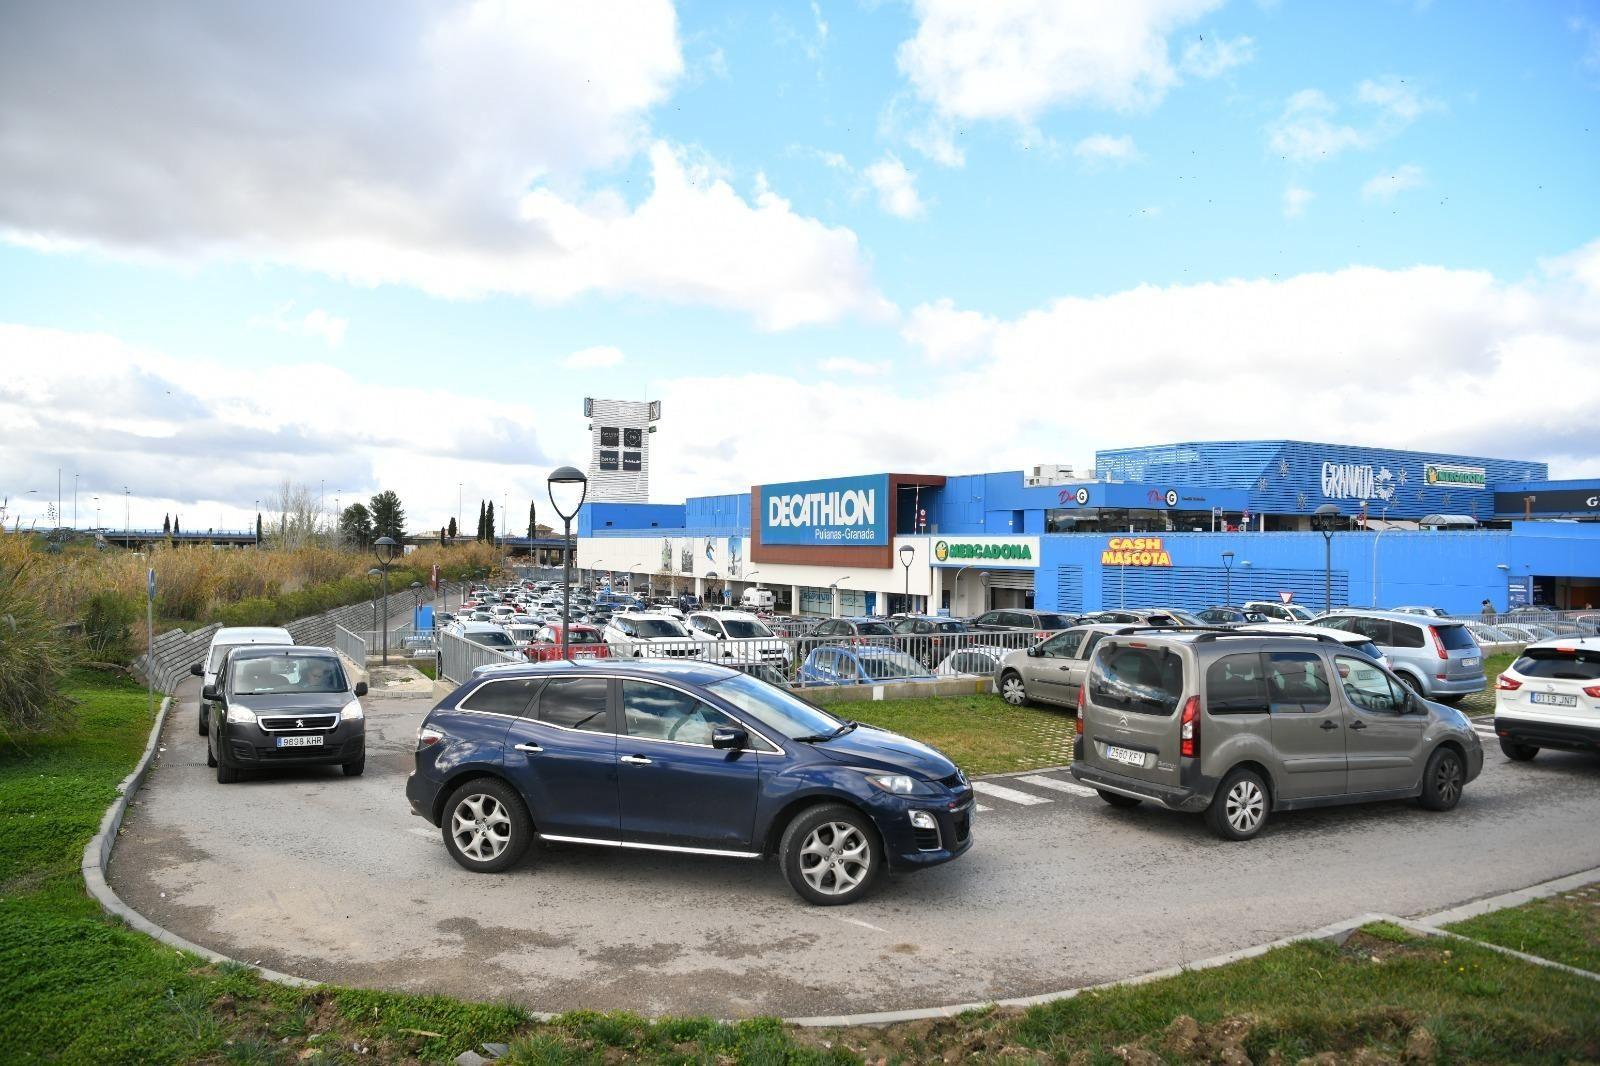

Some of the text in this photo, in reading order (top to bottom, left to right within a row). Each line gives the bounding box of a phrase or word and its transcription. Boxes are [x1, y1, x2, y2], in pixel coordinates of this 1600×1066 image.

[1438, 470, 1485, 484] MERCADONA
[769, 488, 875, 527] DECATHLON
[1585, 496, 1600, 508] G
[1108, 538, 1161, 550] CASH
[949, 543, 1032, 560] MERCADONA
[1102, 551, 1170, 566] MASCOTA
[1536, 694, 1557, 703] 0119
[306, 736, 322, 745] KHR
[1111, 747, 1128, 760] 2560
